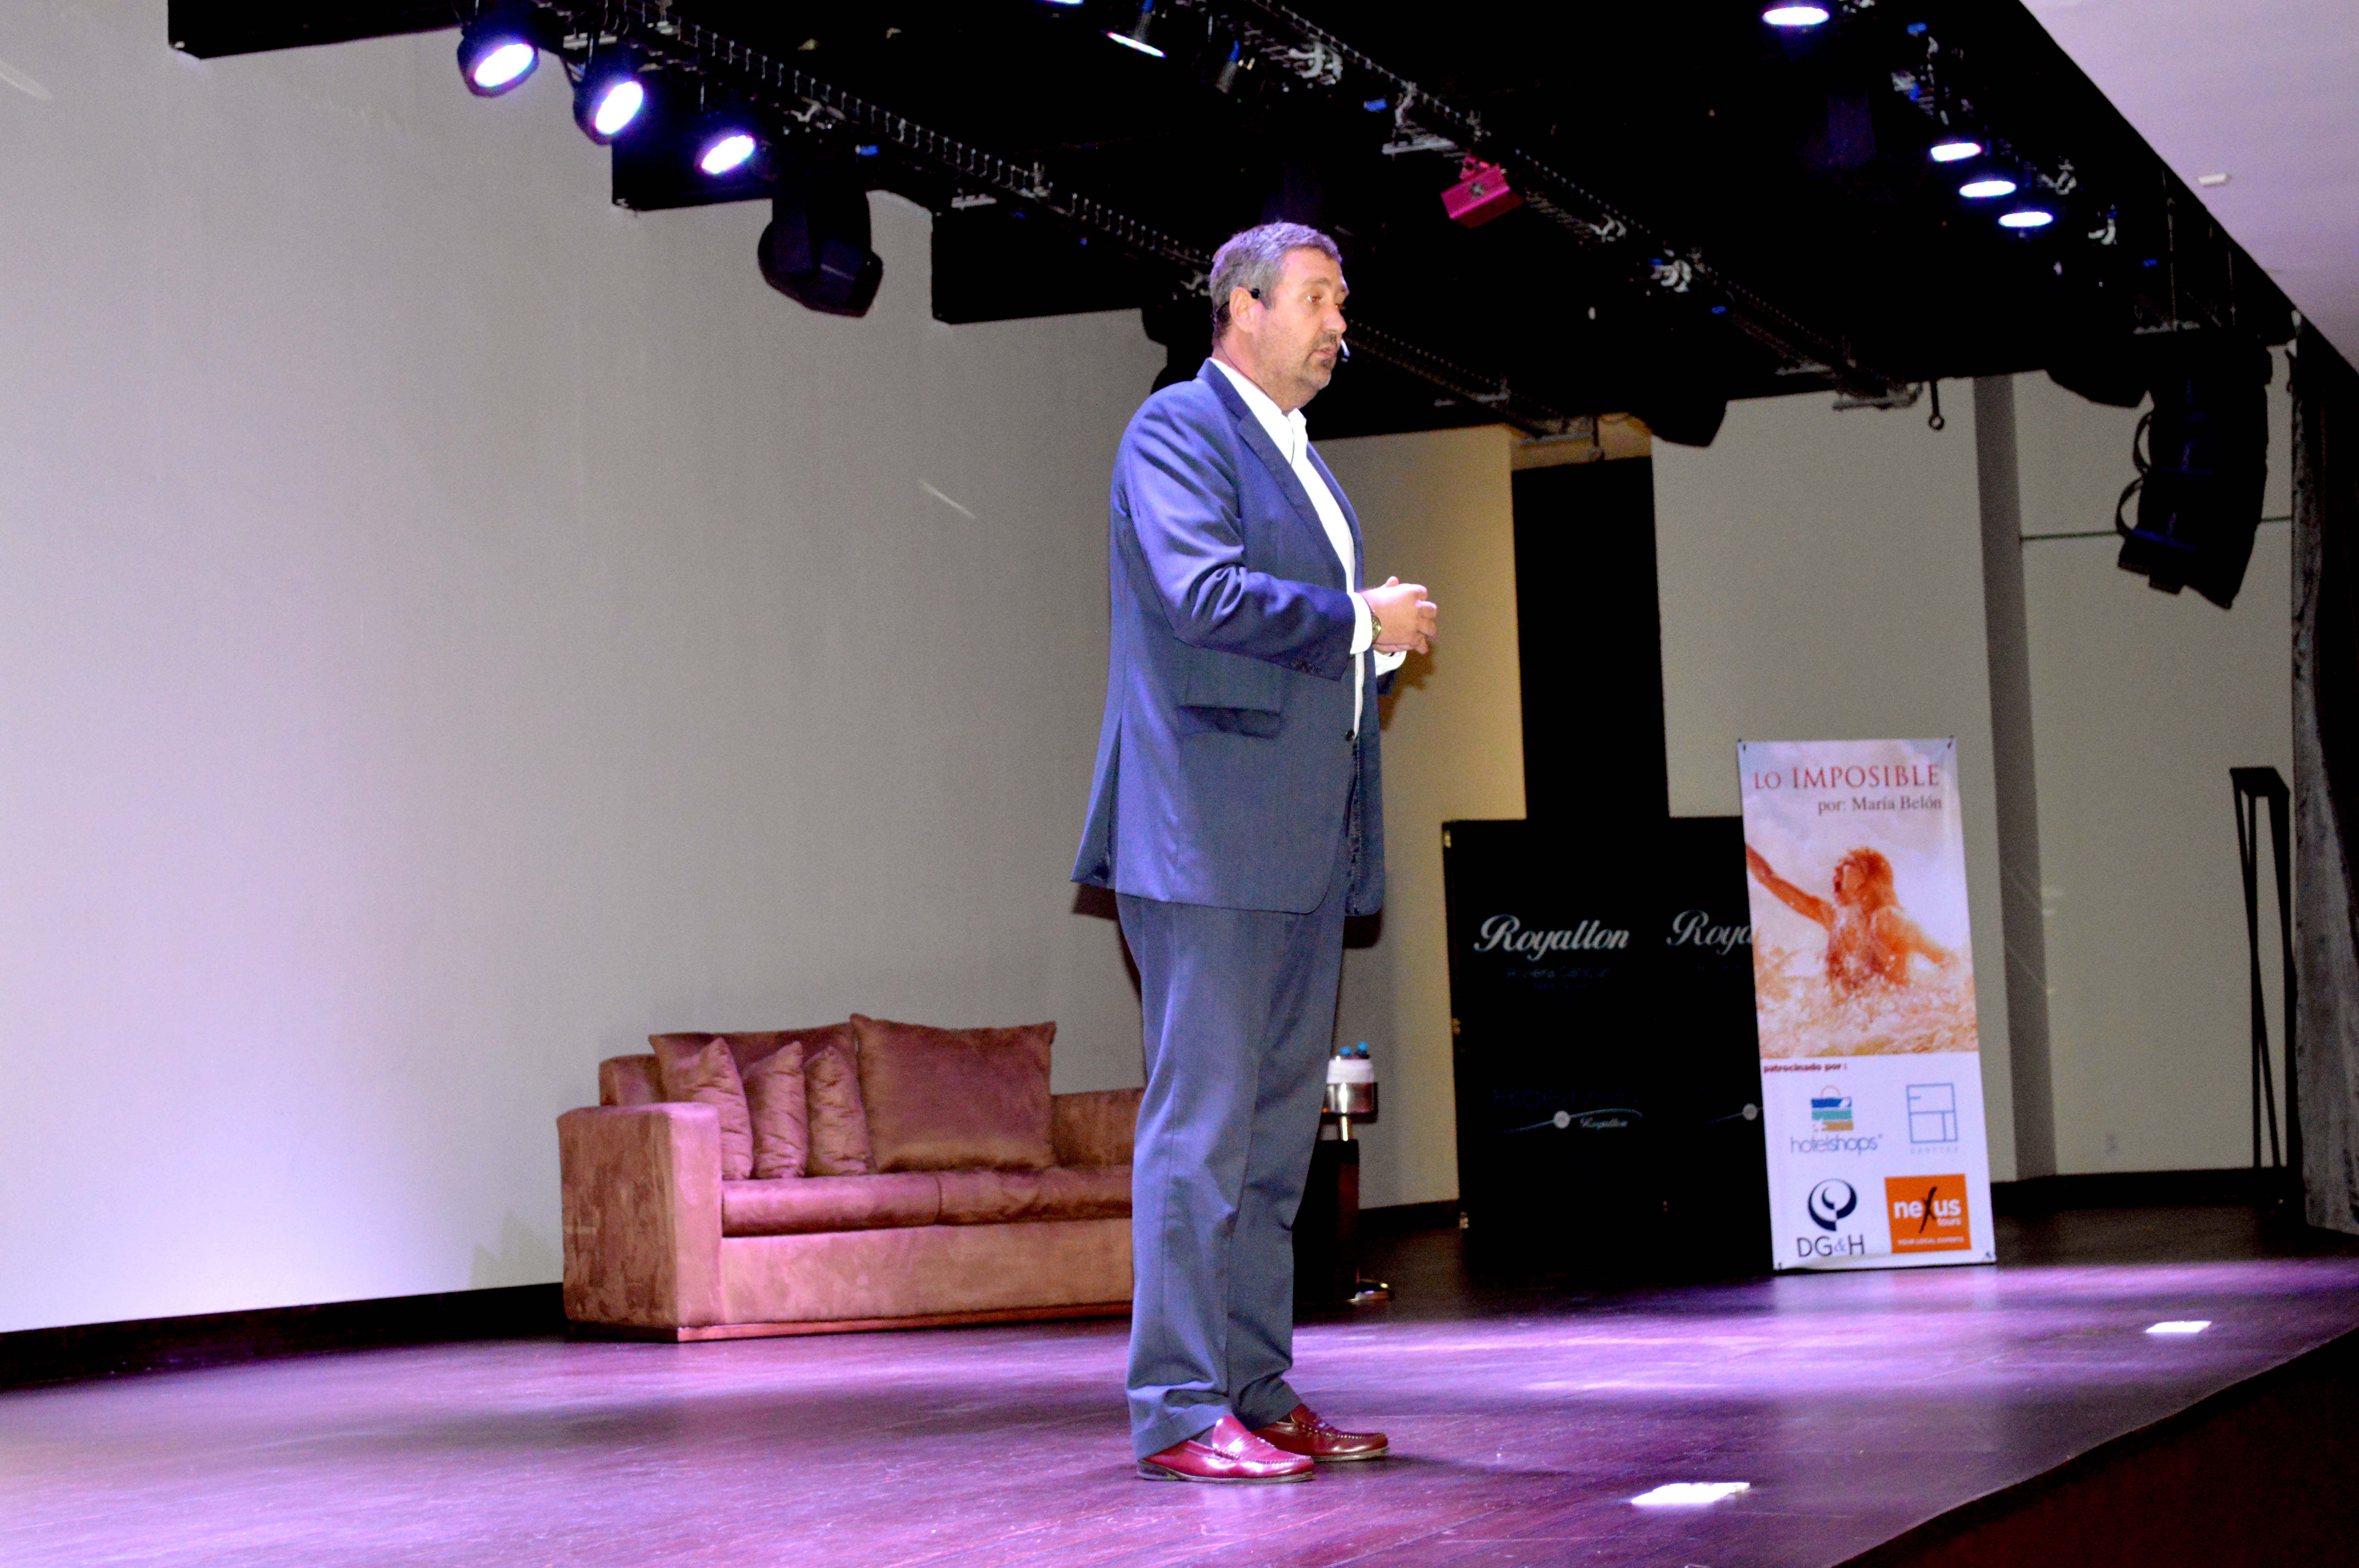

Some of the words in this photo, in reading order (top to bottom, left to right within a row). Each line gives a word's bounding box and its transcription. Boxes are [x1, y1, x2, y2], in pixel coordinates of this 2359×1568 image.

[1754, 771, 1781, 789] LO
[1793, 764, 1939, 789] IMPOSIBLE
[1818, 800, 1846, 815] por:
[1852, 796, 1895, 811] María
[1900, 794, 1942, 810] Belón
[1473, 913, 1630, 962] Royalton
[1665, 909, 1751, 956] Roya
[1764, 1062, 1821, 1073] patrocinado
[1797, 1234, 1865, 1257] DG&H
